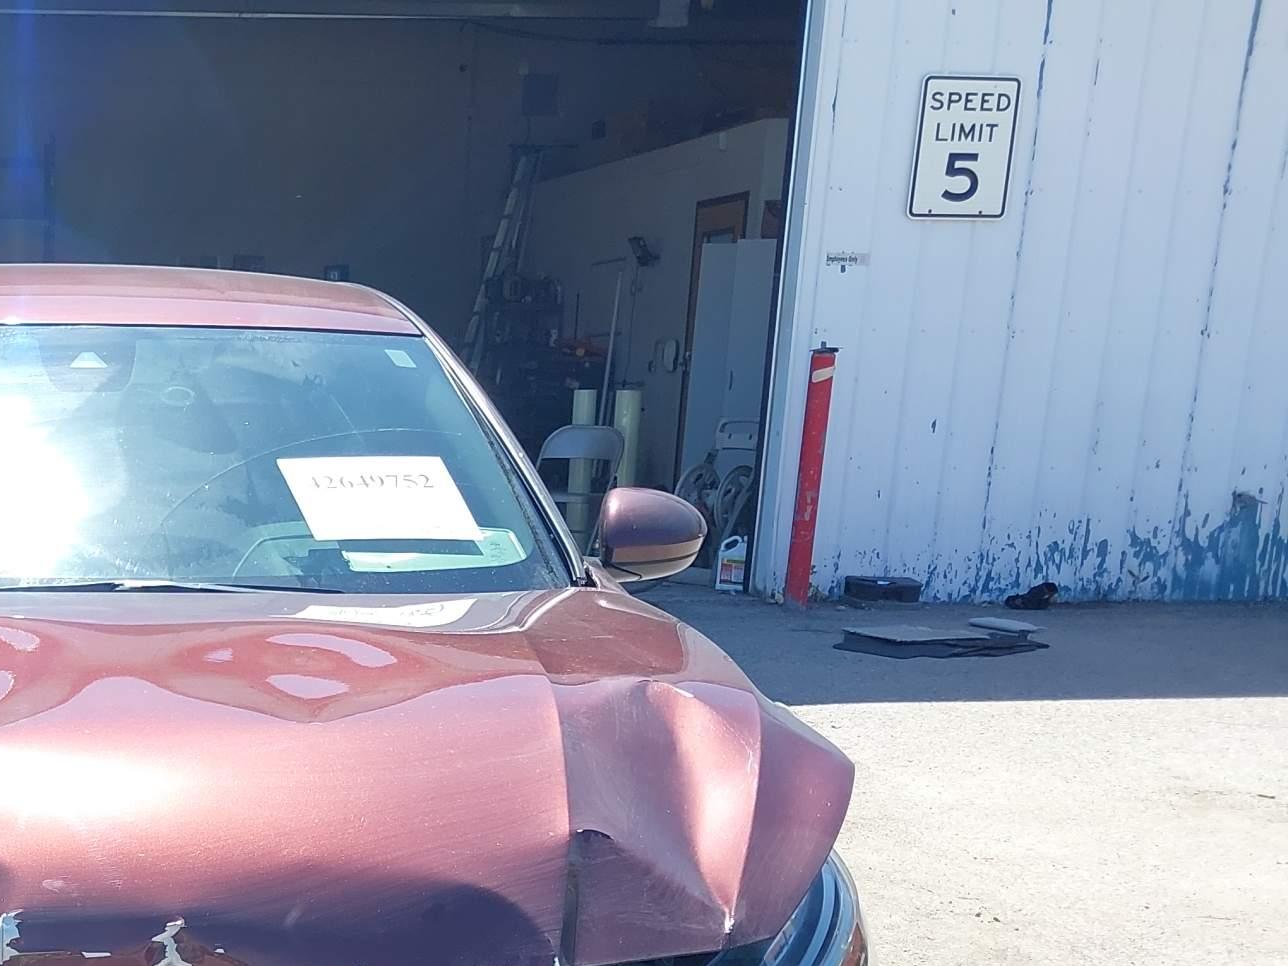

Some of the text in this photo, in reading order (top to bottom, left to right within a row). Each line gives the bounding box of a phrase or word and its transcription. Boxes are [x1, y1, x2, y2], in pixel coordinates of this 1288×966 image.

[929, 91, 1012, 112] SPEED
[934, 122, 999, 143] LIMIT
[940, 152, 979, 202] 5
